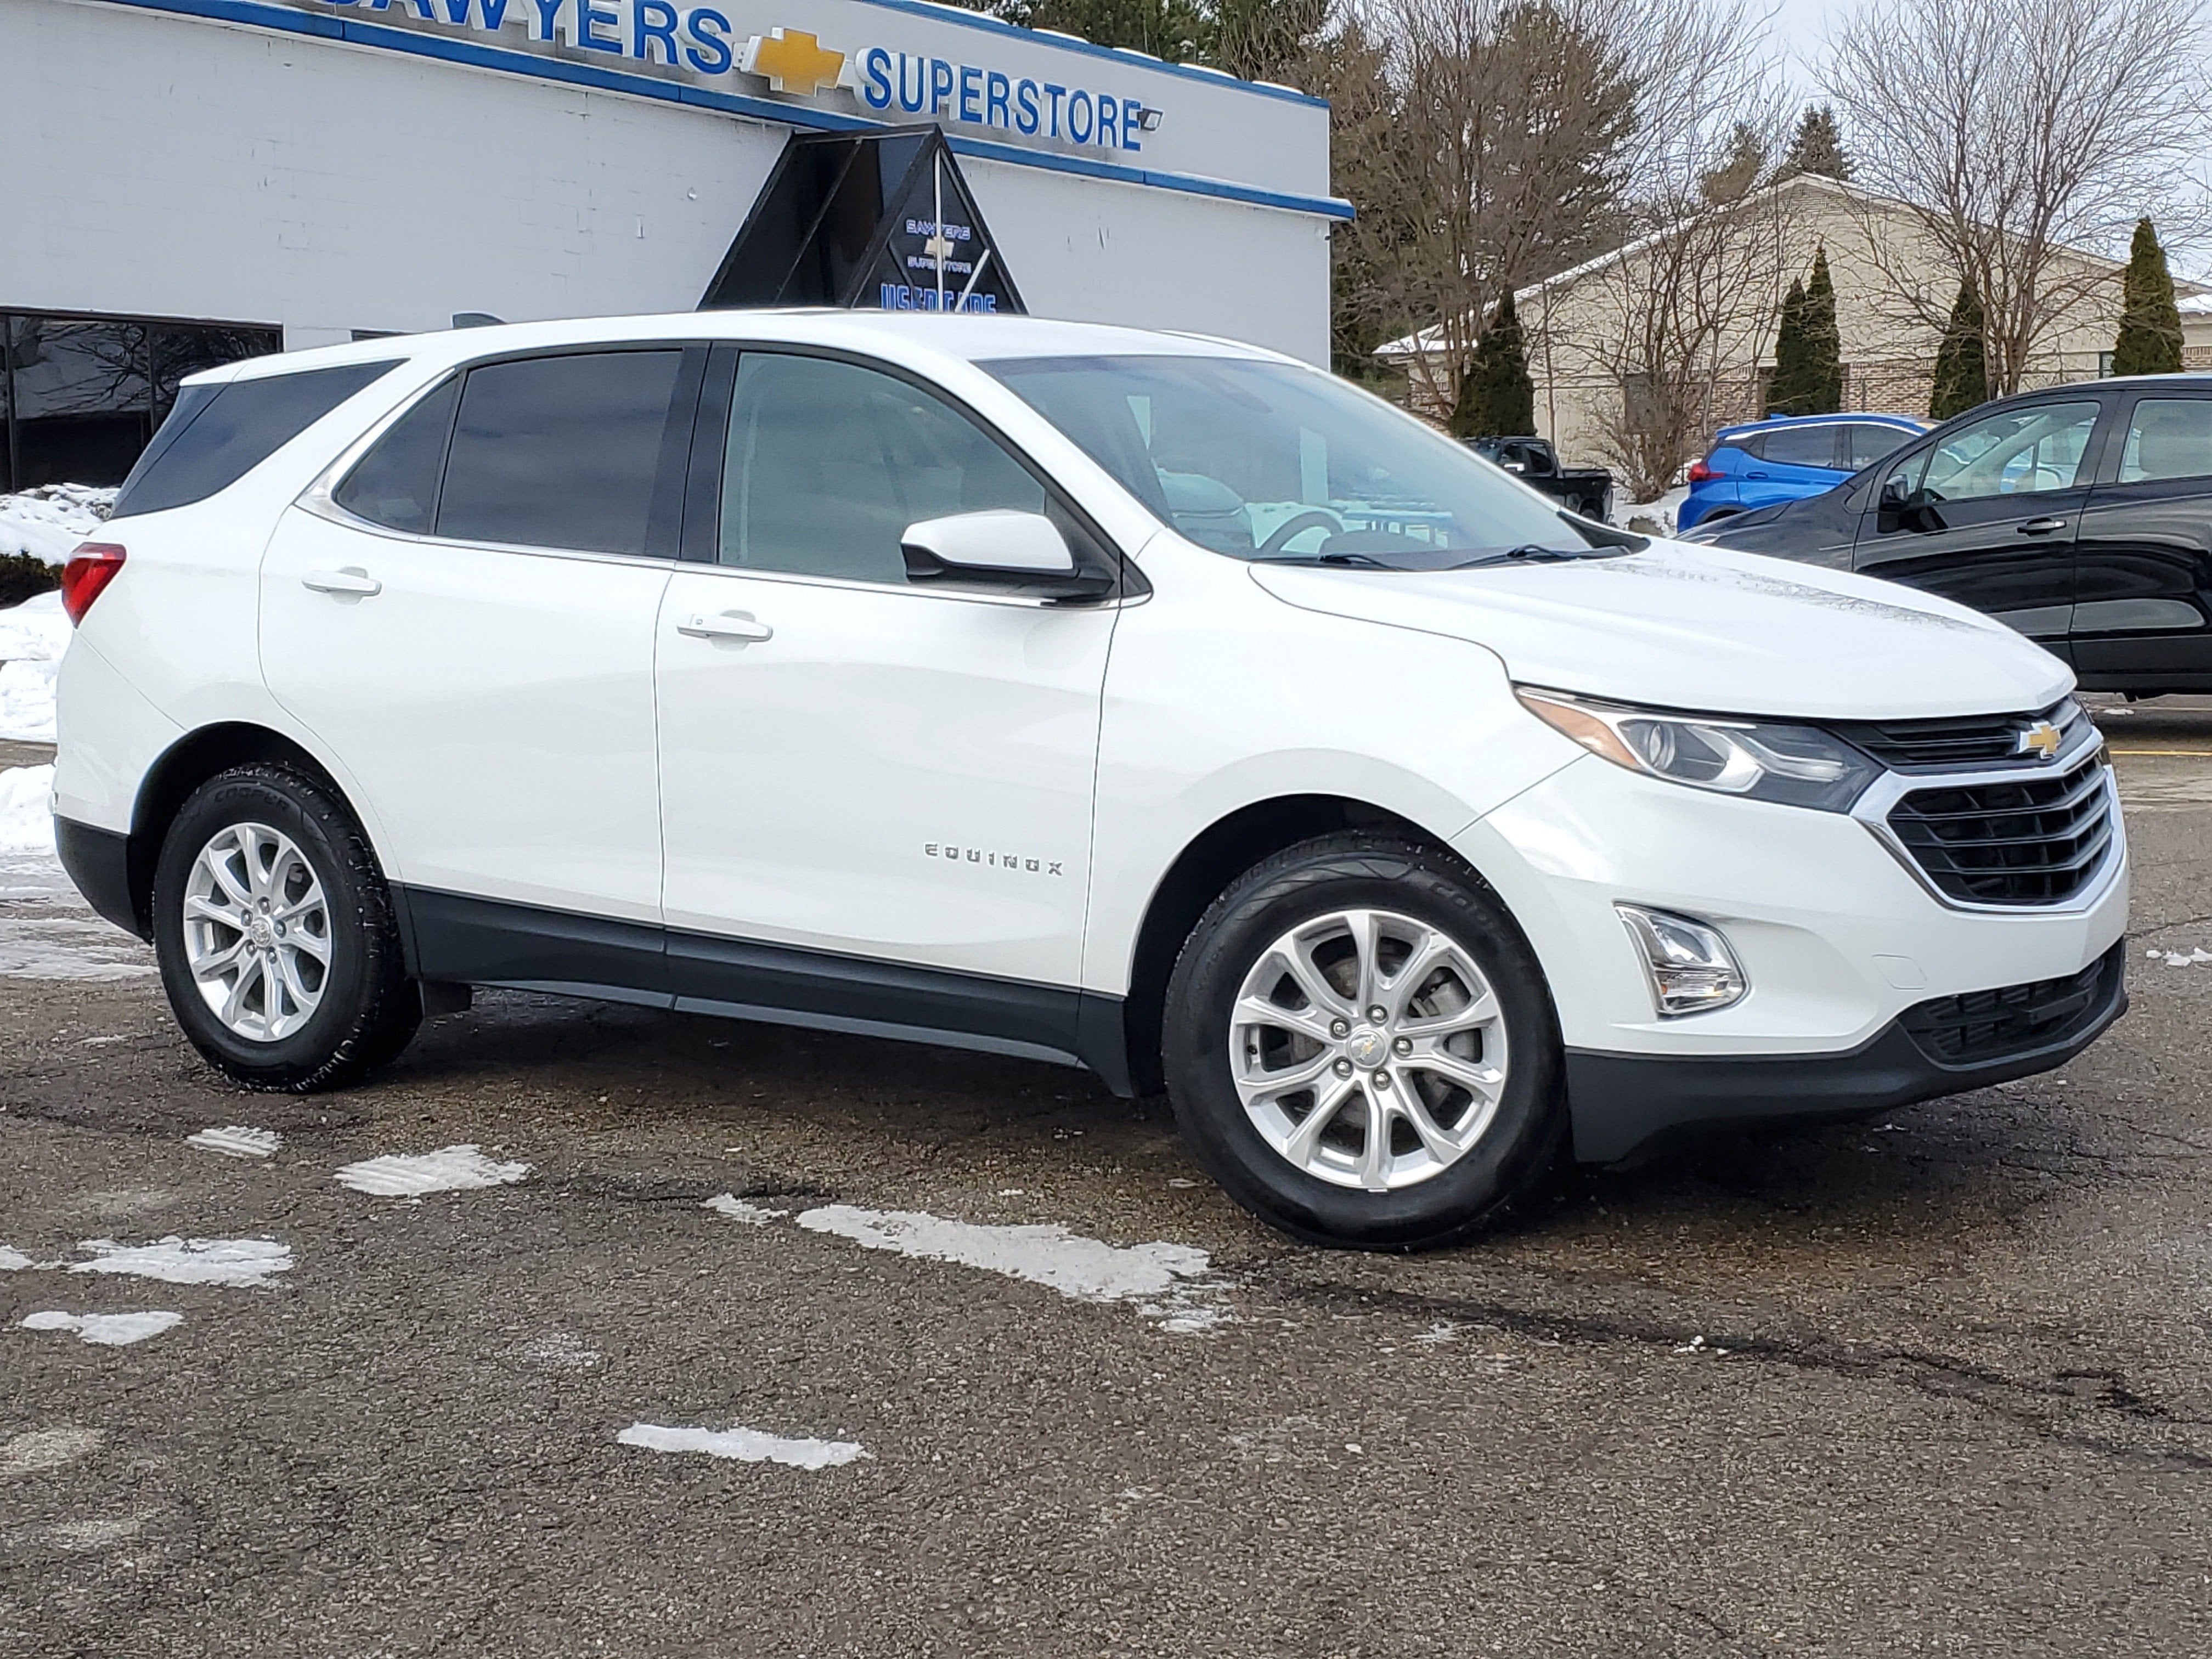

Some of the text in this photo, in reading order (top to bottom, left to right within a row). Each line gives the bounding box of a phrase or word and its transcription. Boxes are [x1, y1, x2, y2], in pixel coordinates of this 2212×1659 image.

[315, 0, 1142, 151] YERS SUPERSTORE
[924, 843, 1063, 876] EQUINOX
